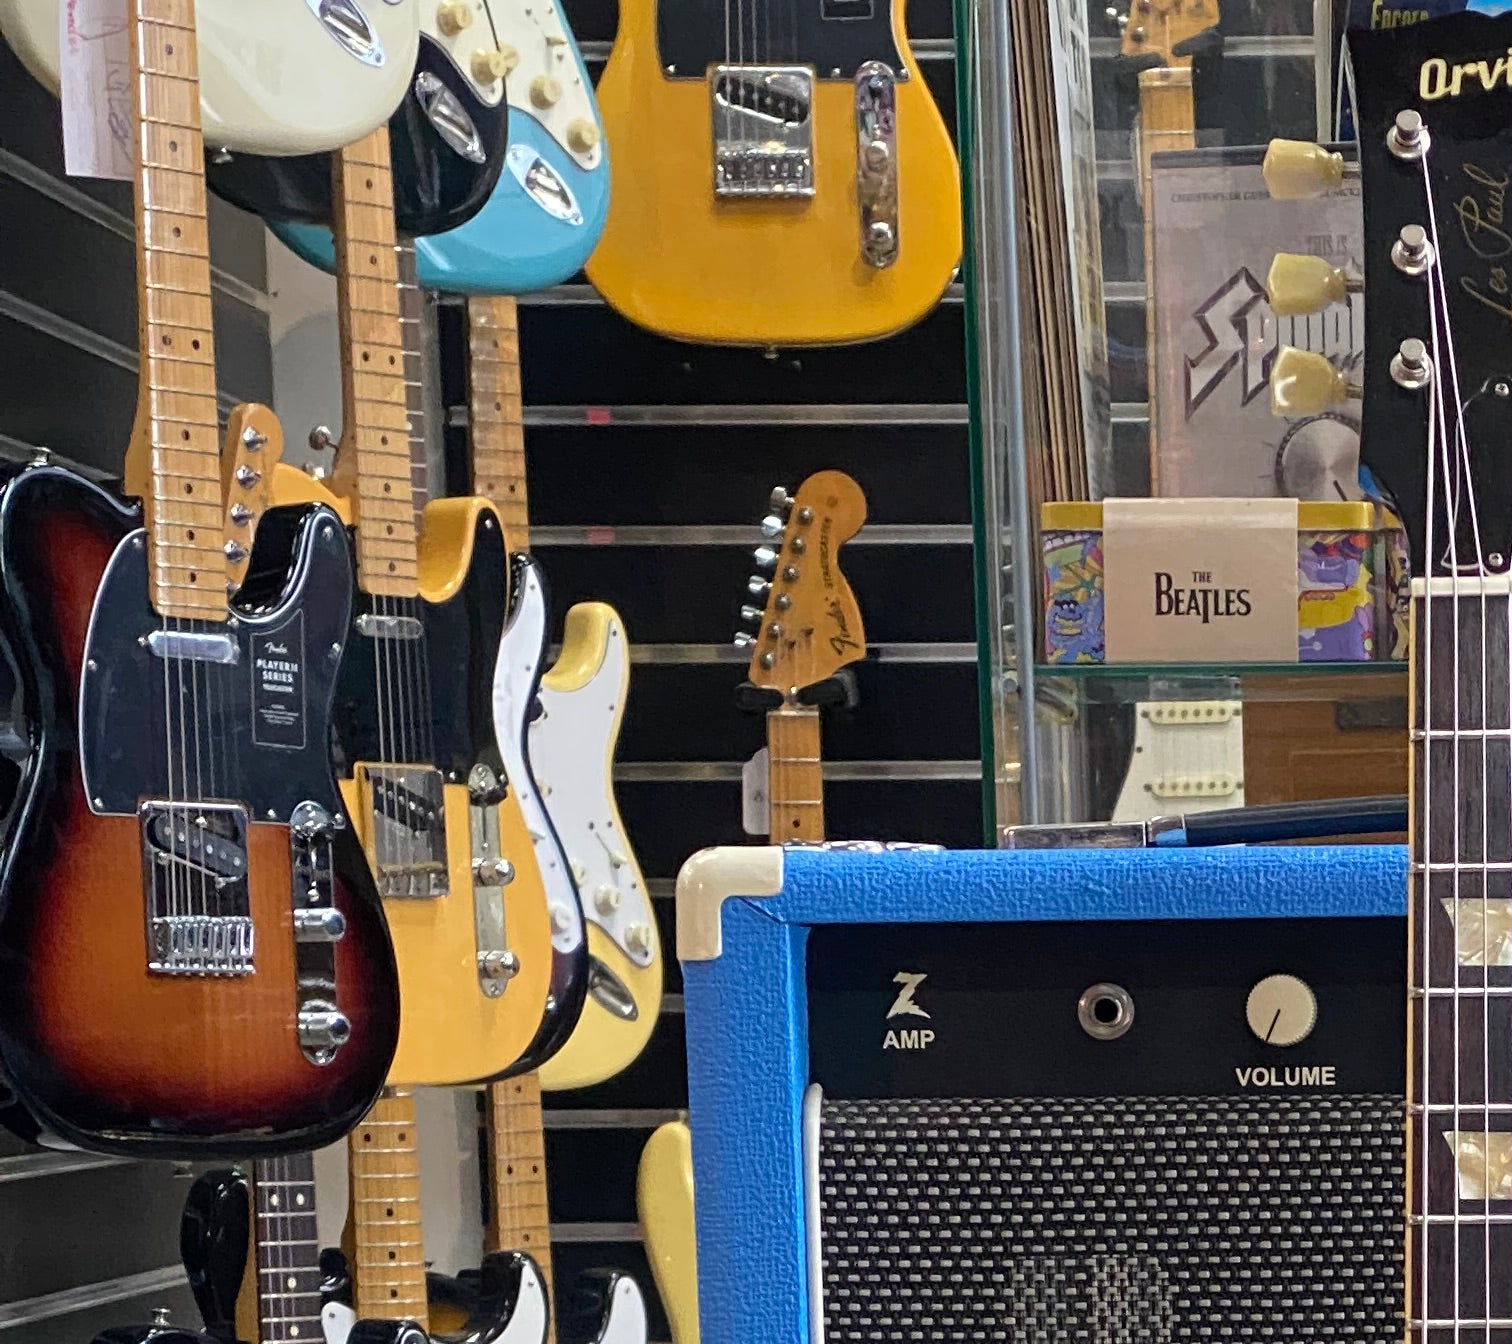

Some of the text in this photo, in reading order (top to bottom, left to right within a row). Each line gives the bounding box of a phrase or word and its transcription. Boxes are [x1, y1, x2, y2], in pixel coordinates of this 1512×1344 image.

[1453, 163, 1512, 259] Paul
[1192, 571, 1213, 583] THE
[1154, 572, 1252, 624] BEATLES
[262, 670, 294, 683] SERIES
[882, 1030, 936, 1049] AMP
[1236, 1066, 1337, 1087] VOLUME
